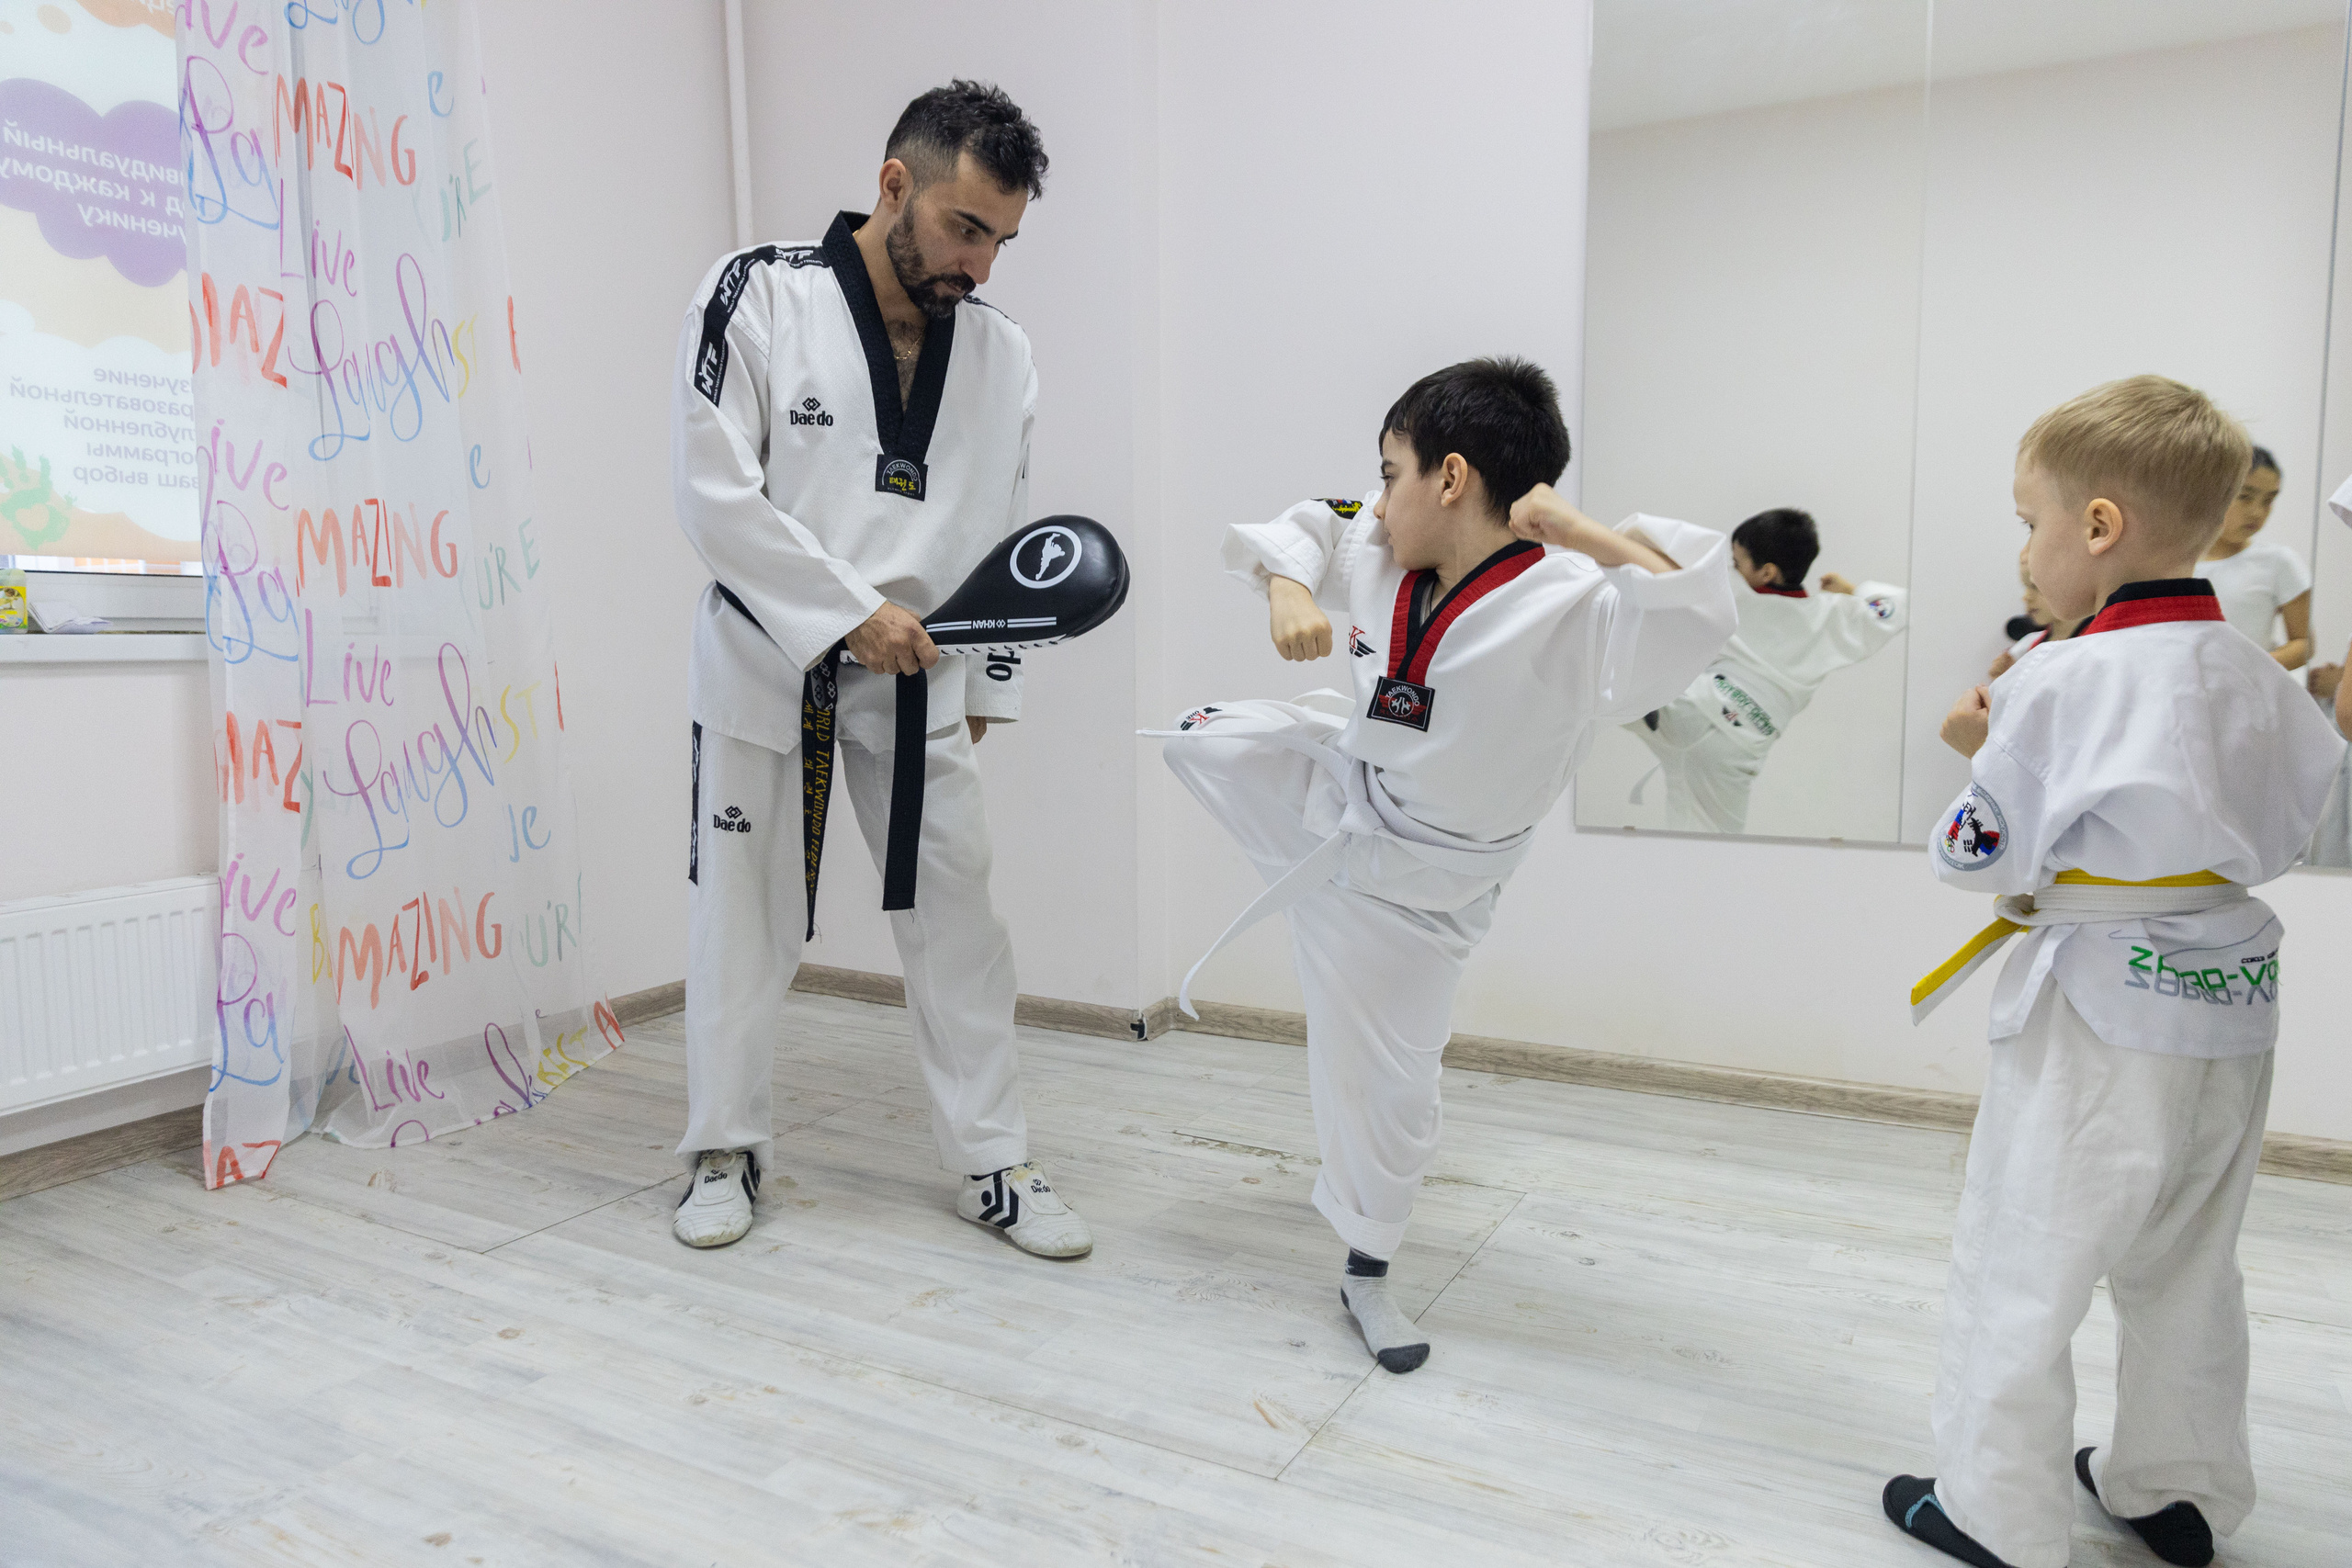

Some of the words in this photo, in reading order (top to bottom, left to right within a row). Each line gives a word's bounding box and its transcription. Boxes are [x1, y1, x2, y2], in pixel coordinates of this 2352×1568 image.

[887, 462, 918, 482] TAEKWONDO
[972, 619, 996, 630] KHAN
[305, 608, 395, 708] Live
[1385, 684, 1420, 706] TAEKWONDO
[812, 750, 831, 836] TAEKWONDO
[344, 1023, 445, 1112] Live
